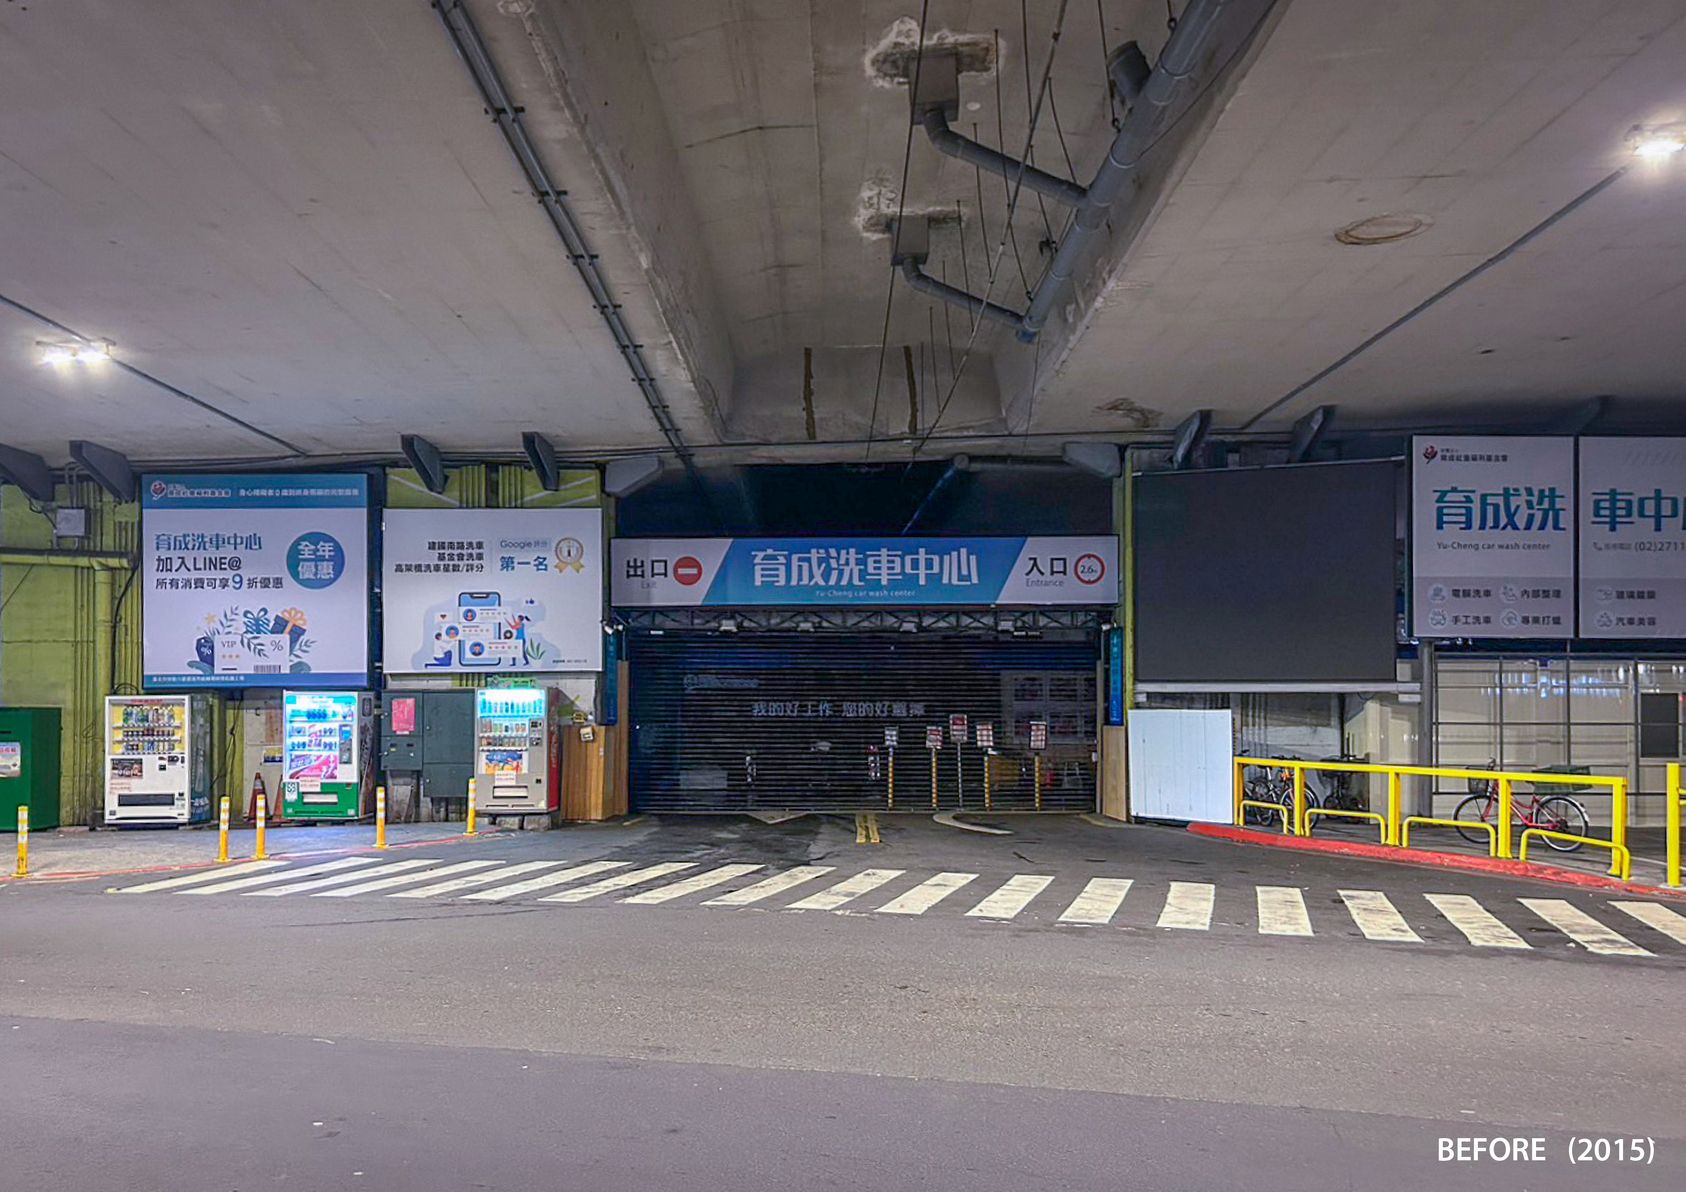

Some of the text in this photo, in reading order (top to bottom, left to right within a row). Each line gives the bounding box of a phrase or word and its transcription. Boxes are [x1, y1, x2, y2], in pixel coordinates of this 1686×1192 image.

[1433, 486, 1567, 531] 育成洗
[155, 533, 262, 551] 育成洗車中心
[298, 541, 334, 559] 全年
[428, 541, 484, 550] 建國南路洗車
[500, 540, 532, 550] Google
[1437, 541, 1479, 551] Yu-Cheng
[1498, 541, 1520, 550] wash
[1522, 542, 1550, 550] center
[155, 555, 242, 573] 加入LINE@
[437, 552, 484, 562] 基金會洗車
[500, 556, 549, 572] 第一名
[298, 562, 335, 579] 優惠
[626, 557, 668, 579] 出口
[751, 548, 979, 586] 育成洗車中心
[1025, 557, 1068, 576] 入口
[1026, 579, 1065, 587] Entrance
[869, 590, 888, 598] wash
[890, 590, 916, 598] center
[1452, 615, 1492, 625] 手工洗車
[221, 640, 237, 649] VIP
